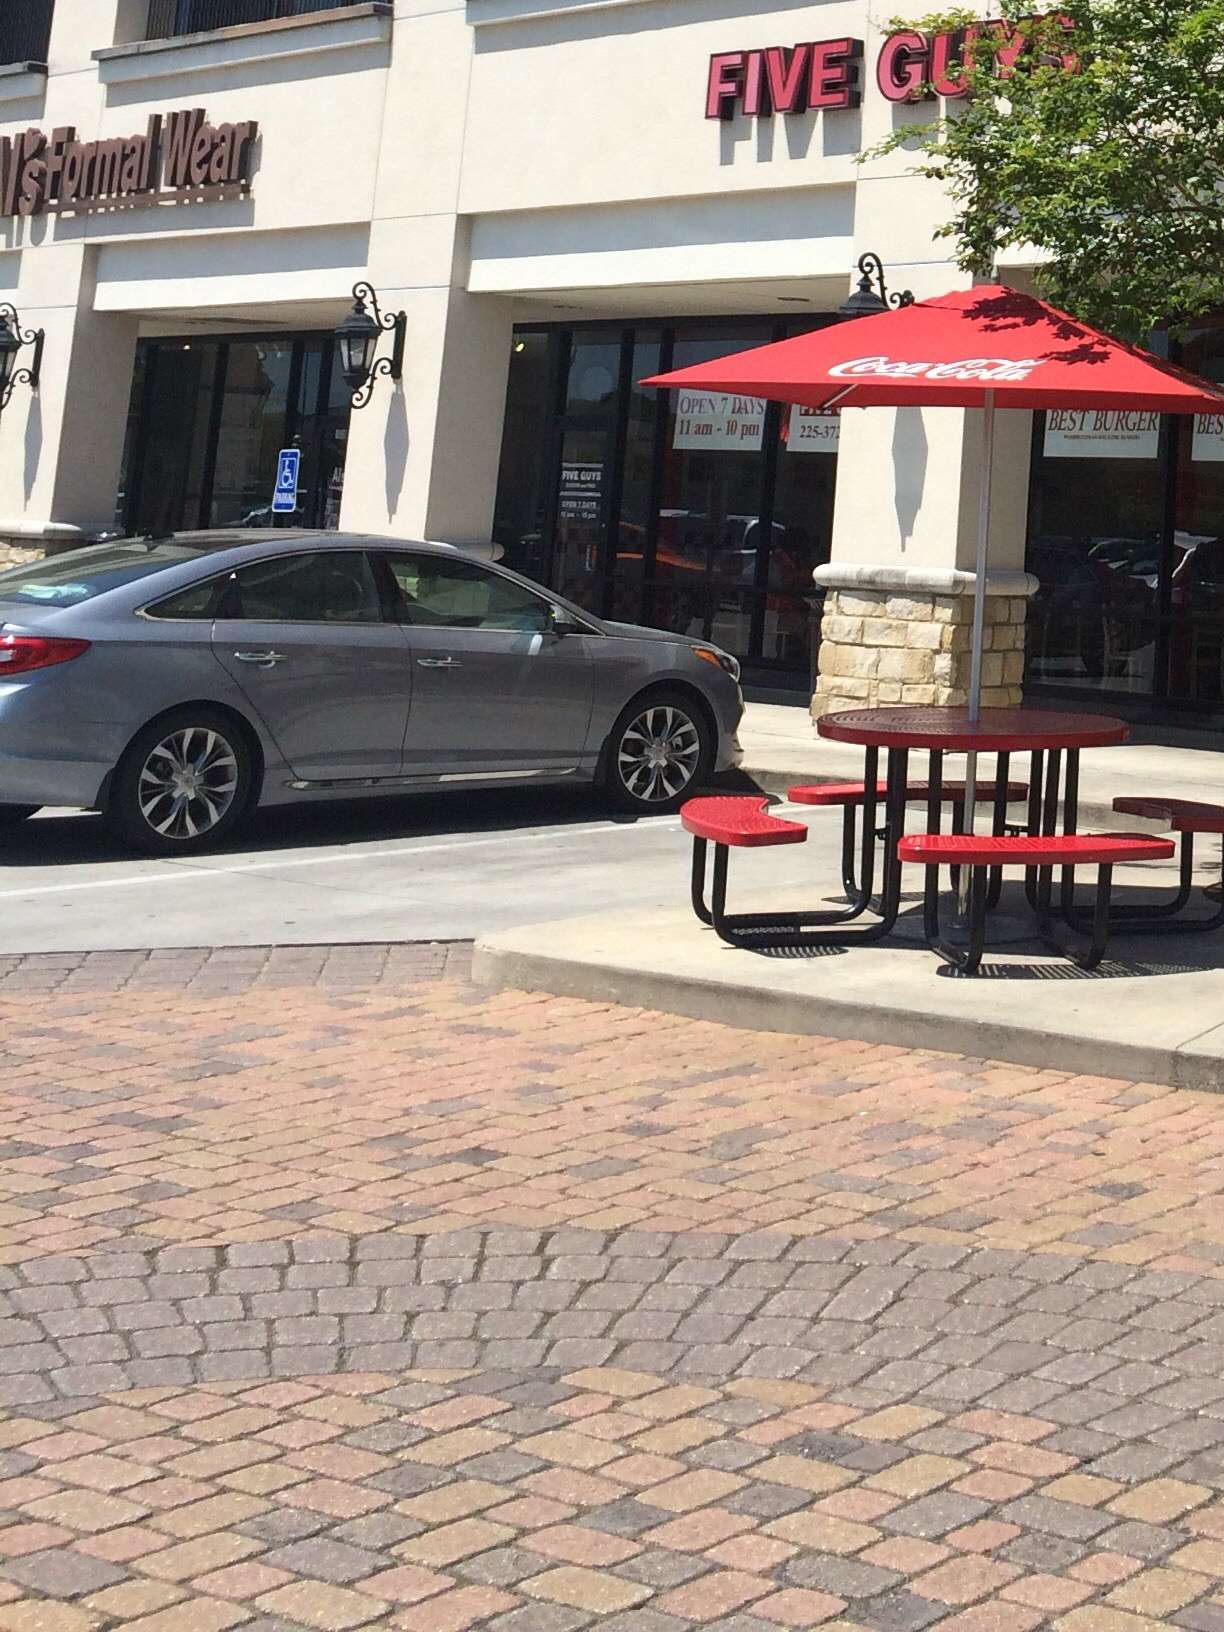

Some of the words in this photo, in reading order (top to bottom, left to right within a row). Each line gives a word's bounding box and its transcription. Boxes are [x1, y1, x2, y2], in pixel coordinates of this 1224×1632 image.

[705, 37, 865, 121] FIVE
[877, 13, 1081, 101] GUY
[0, 127, 47, 216] l's
[44, 114, 162, 200] Formal
[163, 108, 258, 186] Wear
[828, 357, 1048, 381] Coca-Cola
[680, 397, 716, 415] OPEN
[720, 397, 729, 415] 7
[731, 397, 764, 416] DAYS
[679, 420, 690, 435] 11
[694, 424, 713, 436] am
[726, 420, 738, 436] 10
[740, 424, 760, 440] pm
[1048, 409, 1088, 431] BEST
[1093, 410, 1159, 432] BURGER
[562, 470, 579, 480] FIVE
[580, 470, 602, 481] GUYS
